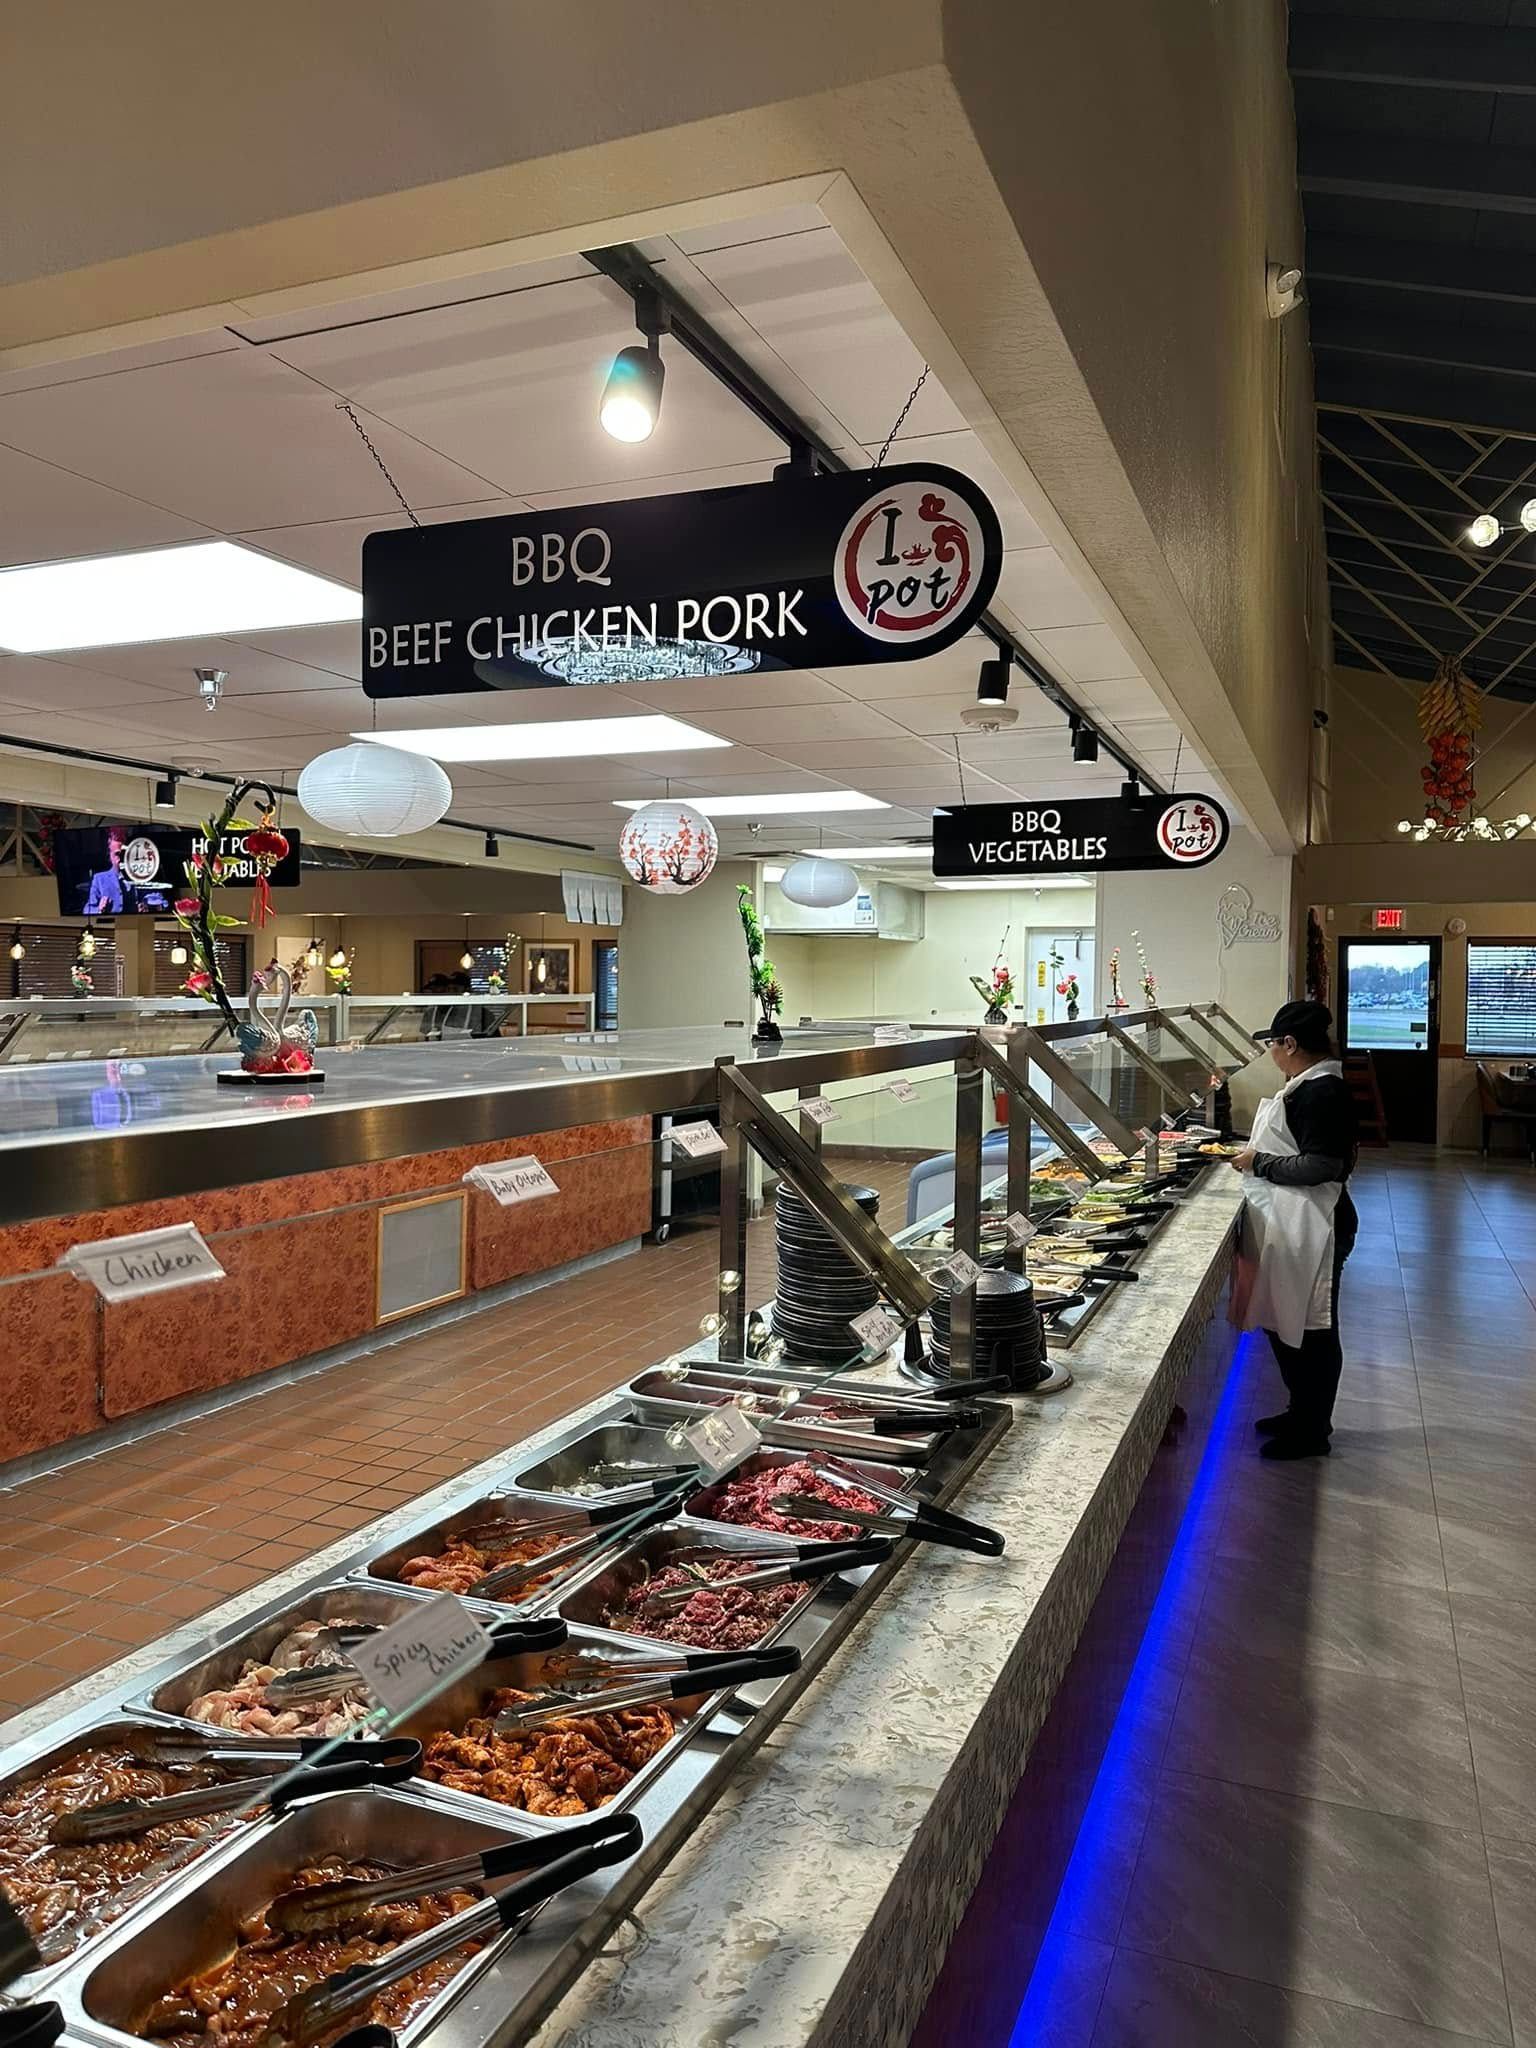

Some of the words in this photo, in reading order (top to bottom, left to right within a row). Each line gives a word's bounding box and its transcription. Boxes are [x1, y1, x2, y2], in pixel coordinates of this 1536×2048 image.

[875, 507, 902, 566] I
[512, 527, 611, 586] BBQ
[867, 566, 951, 624] pot
[369, 620, 452, 668] BEEF
[466, 602, 657, 660] CHICKEN
[677, 589, 808, 644] PORK
[1012, 809, 1061, 834] BBQ
[1176, 809, 1187, 832] I
[968, 837, 1108, 863] VEGETABLES
[1172, 833, 1208, 854] pot
[132, 863, 152, 874] pot
[1253, 912, 1276, 927] Ice
[1376, 909, 1402, 928] EXIT
[1239, 925, 1282, 939] Cream
[490, 1178, 520, 1196] Baby
[104, 1251, 202, 1286] Chicken
[373, 1641, 431, 1678] Spicy
[428, 1630, 482, 1676] Chicken
